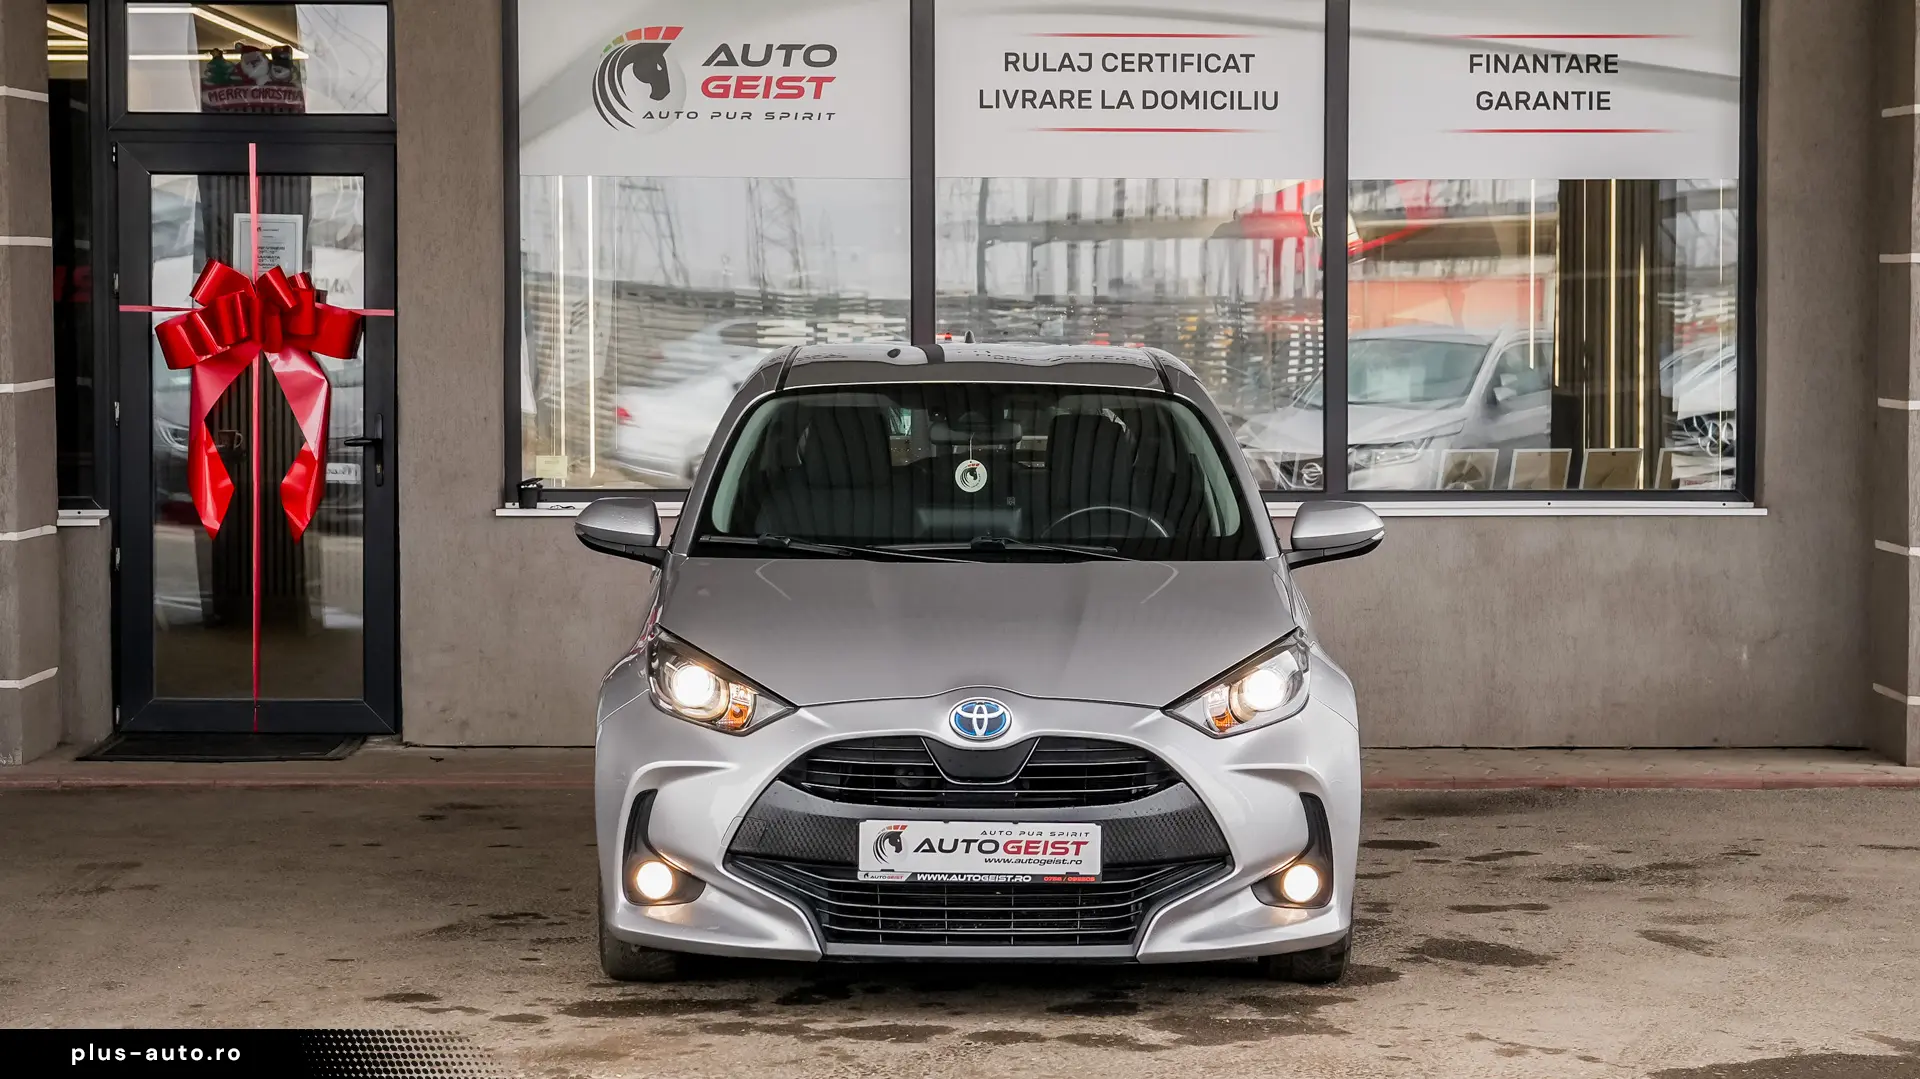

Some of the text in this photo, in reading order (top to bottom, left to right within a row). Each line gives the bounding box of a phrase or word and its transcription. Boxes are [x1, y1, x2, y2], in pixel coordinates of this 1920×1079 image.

[701, 43, 838, 68] AUTO
[1004, 52, 1256, 73] RULAJ CERTIFICAT
[1469, 53, 1619, 74] FINANTARE
[207, 87, 249, 102] MERRY
[700, 75, 837, 100] GEIST
[979, 89, 1279, 111] LIVRARE LA DOMICILIU
[1476, 90, 1611, 111] GARANTIE
[642, 110, 837, 121] AUTO PUR SPIRIT
[984, 856, 1083, 867] www.autogeist.ro
[917, 873, 1032, 882] WWW.AUTOGEIST.RO
